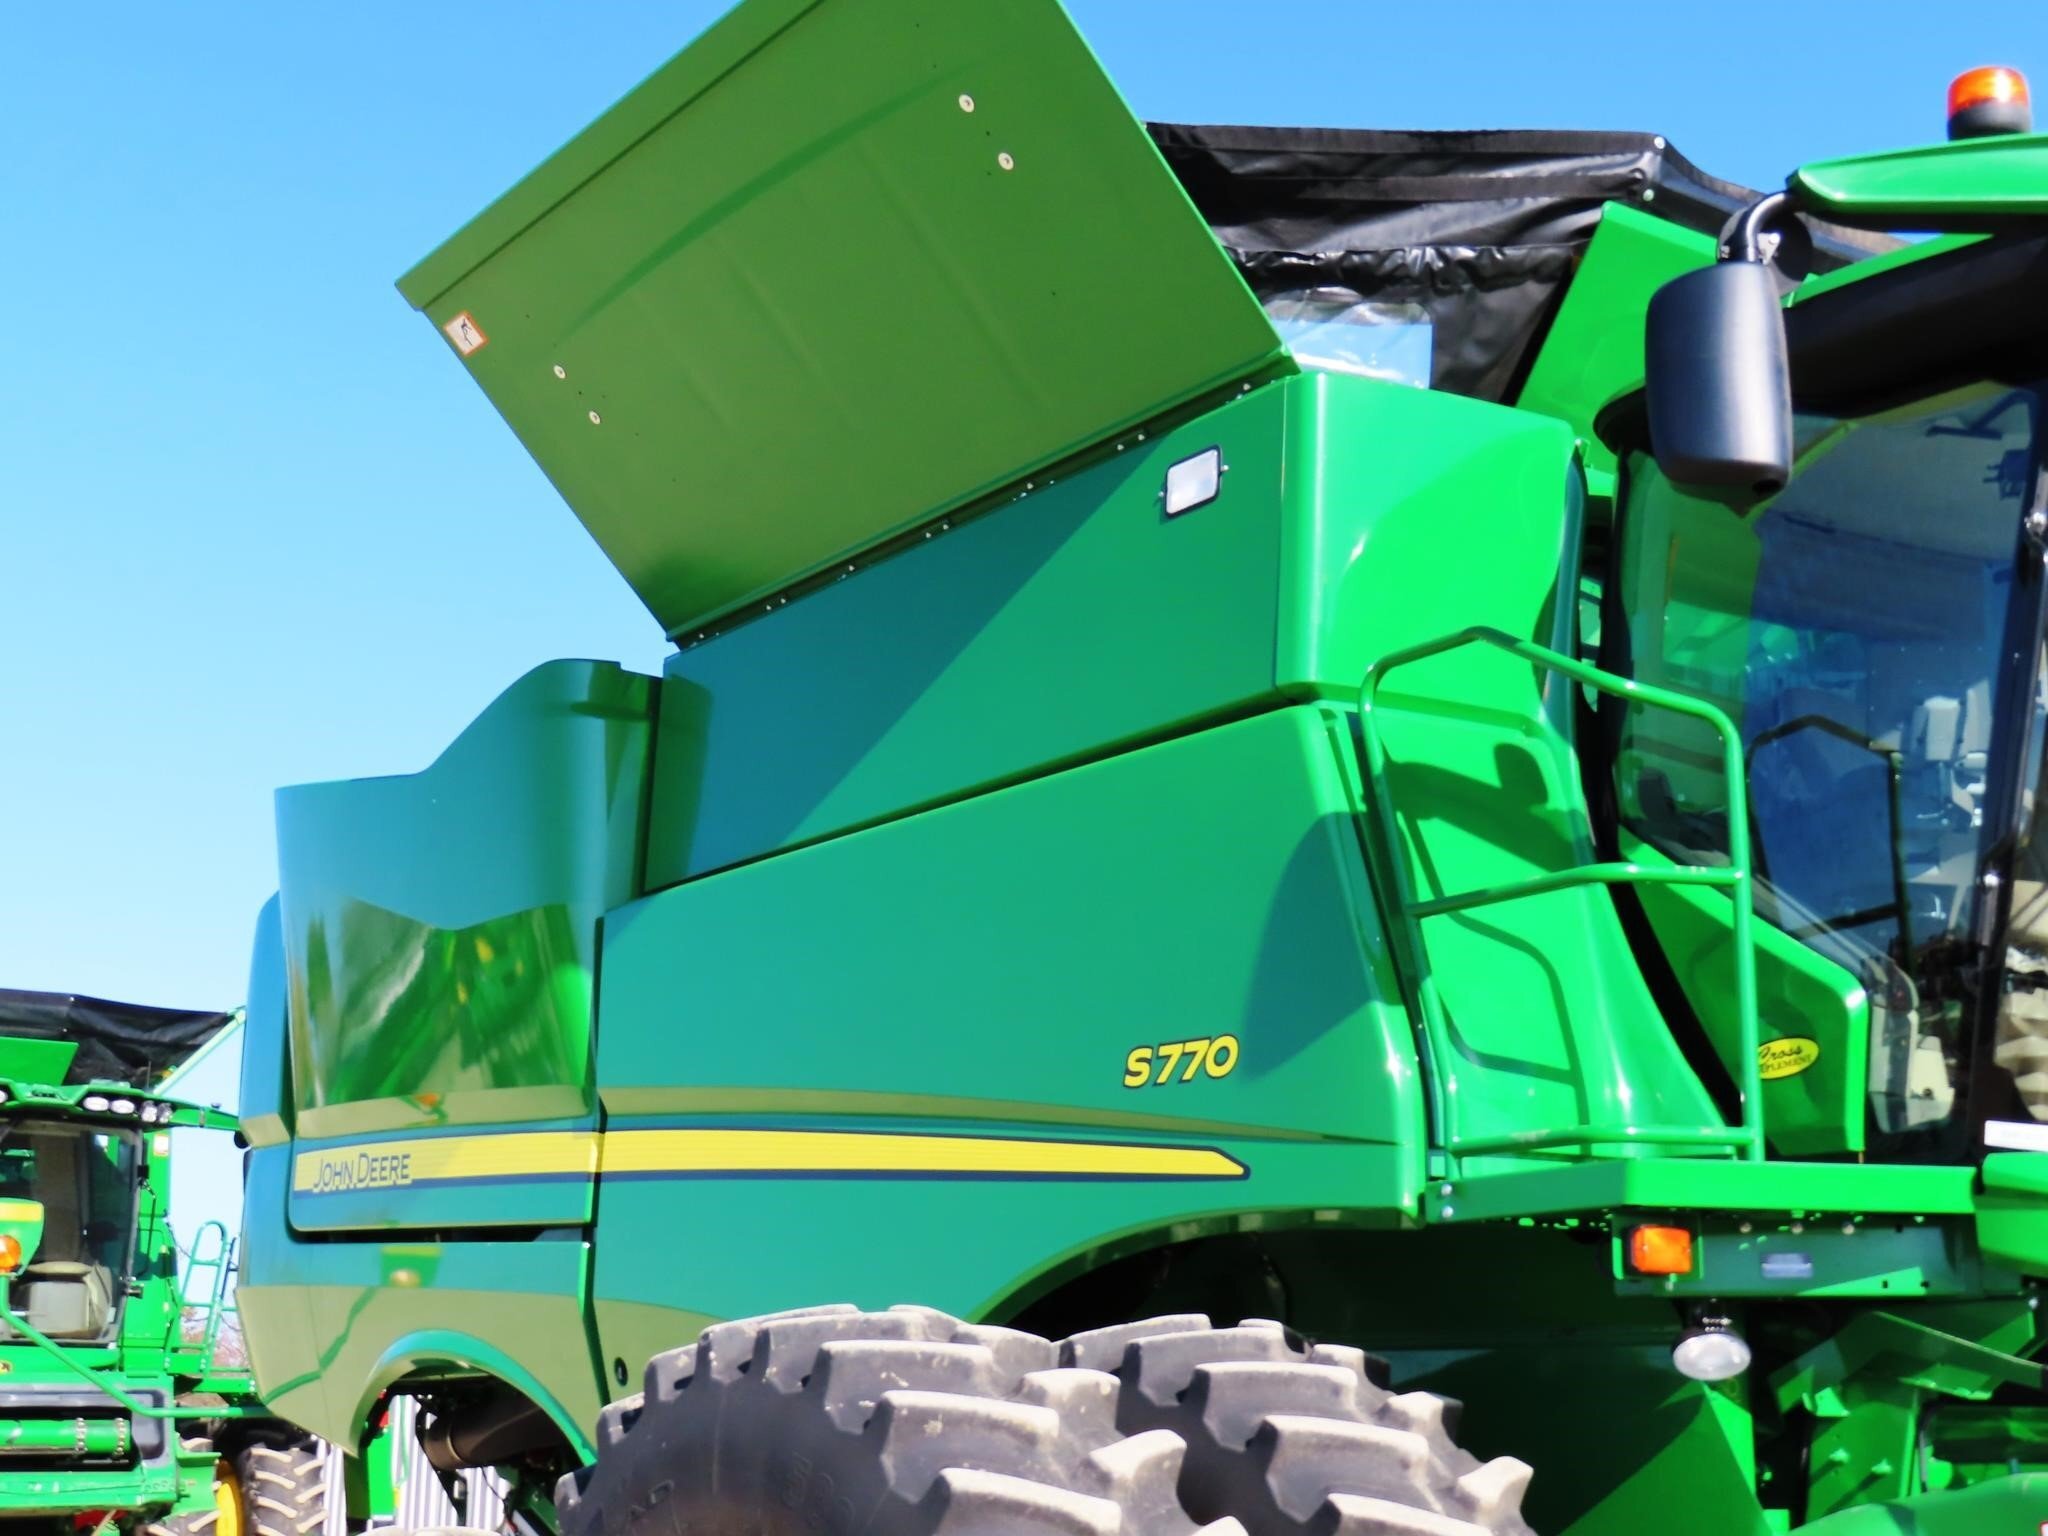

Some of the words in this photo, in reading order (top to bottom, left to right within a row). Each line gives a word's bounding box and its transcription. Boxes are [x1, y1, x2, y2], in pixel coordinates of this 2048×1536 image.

[1123, 1033, 1240, 1089] S770
[312, 1157, 355, 1189] JOHN
[356, 1152, 411, 1185] DEERE
